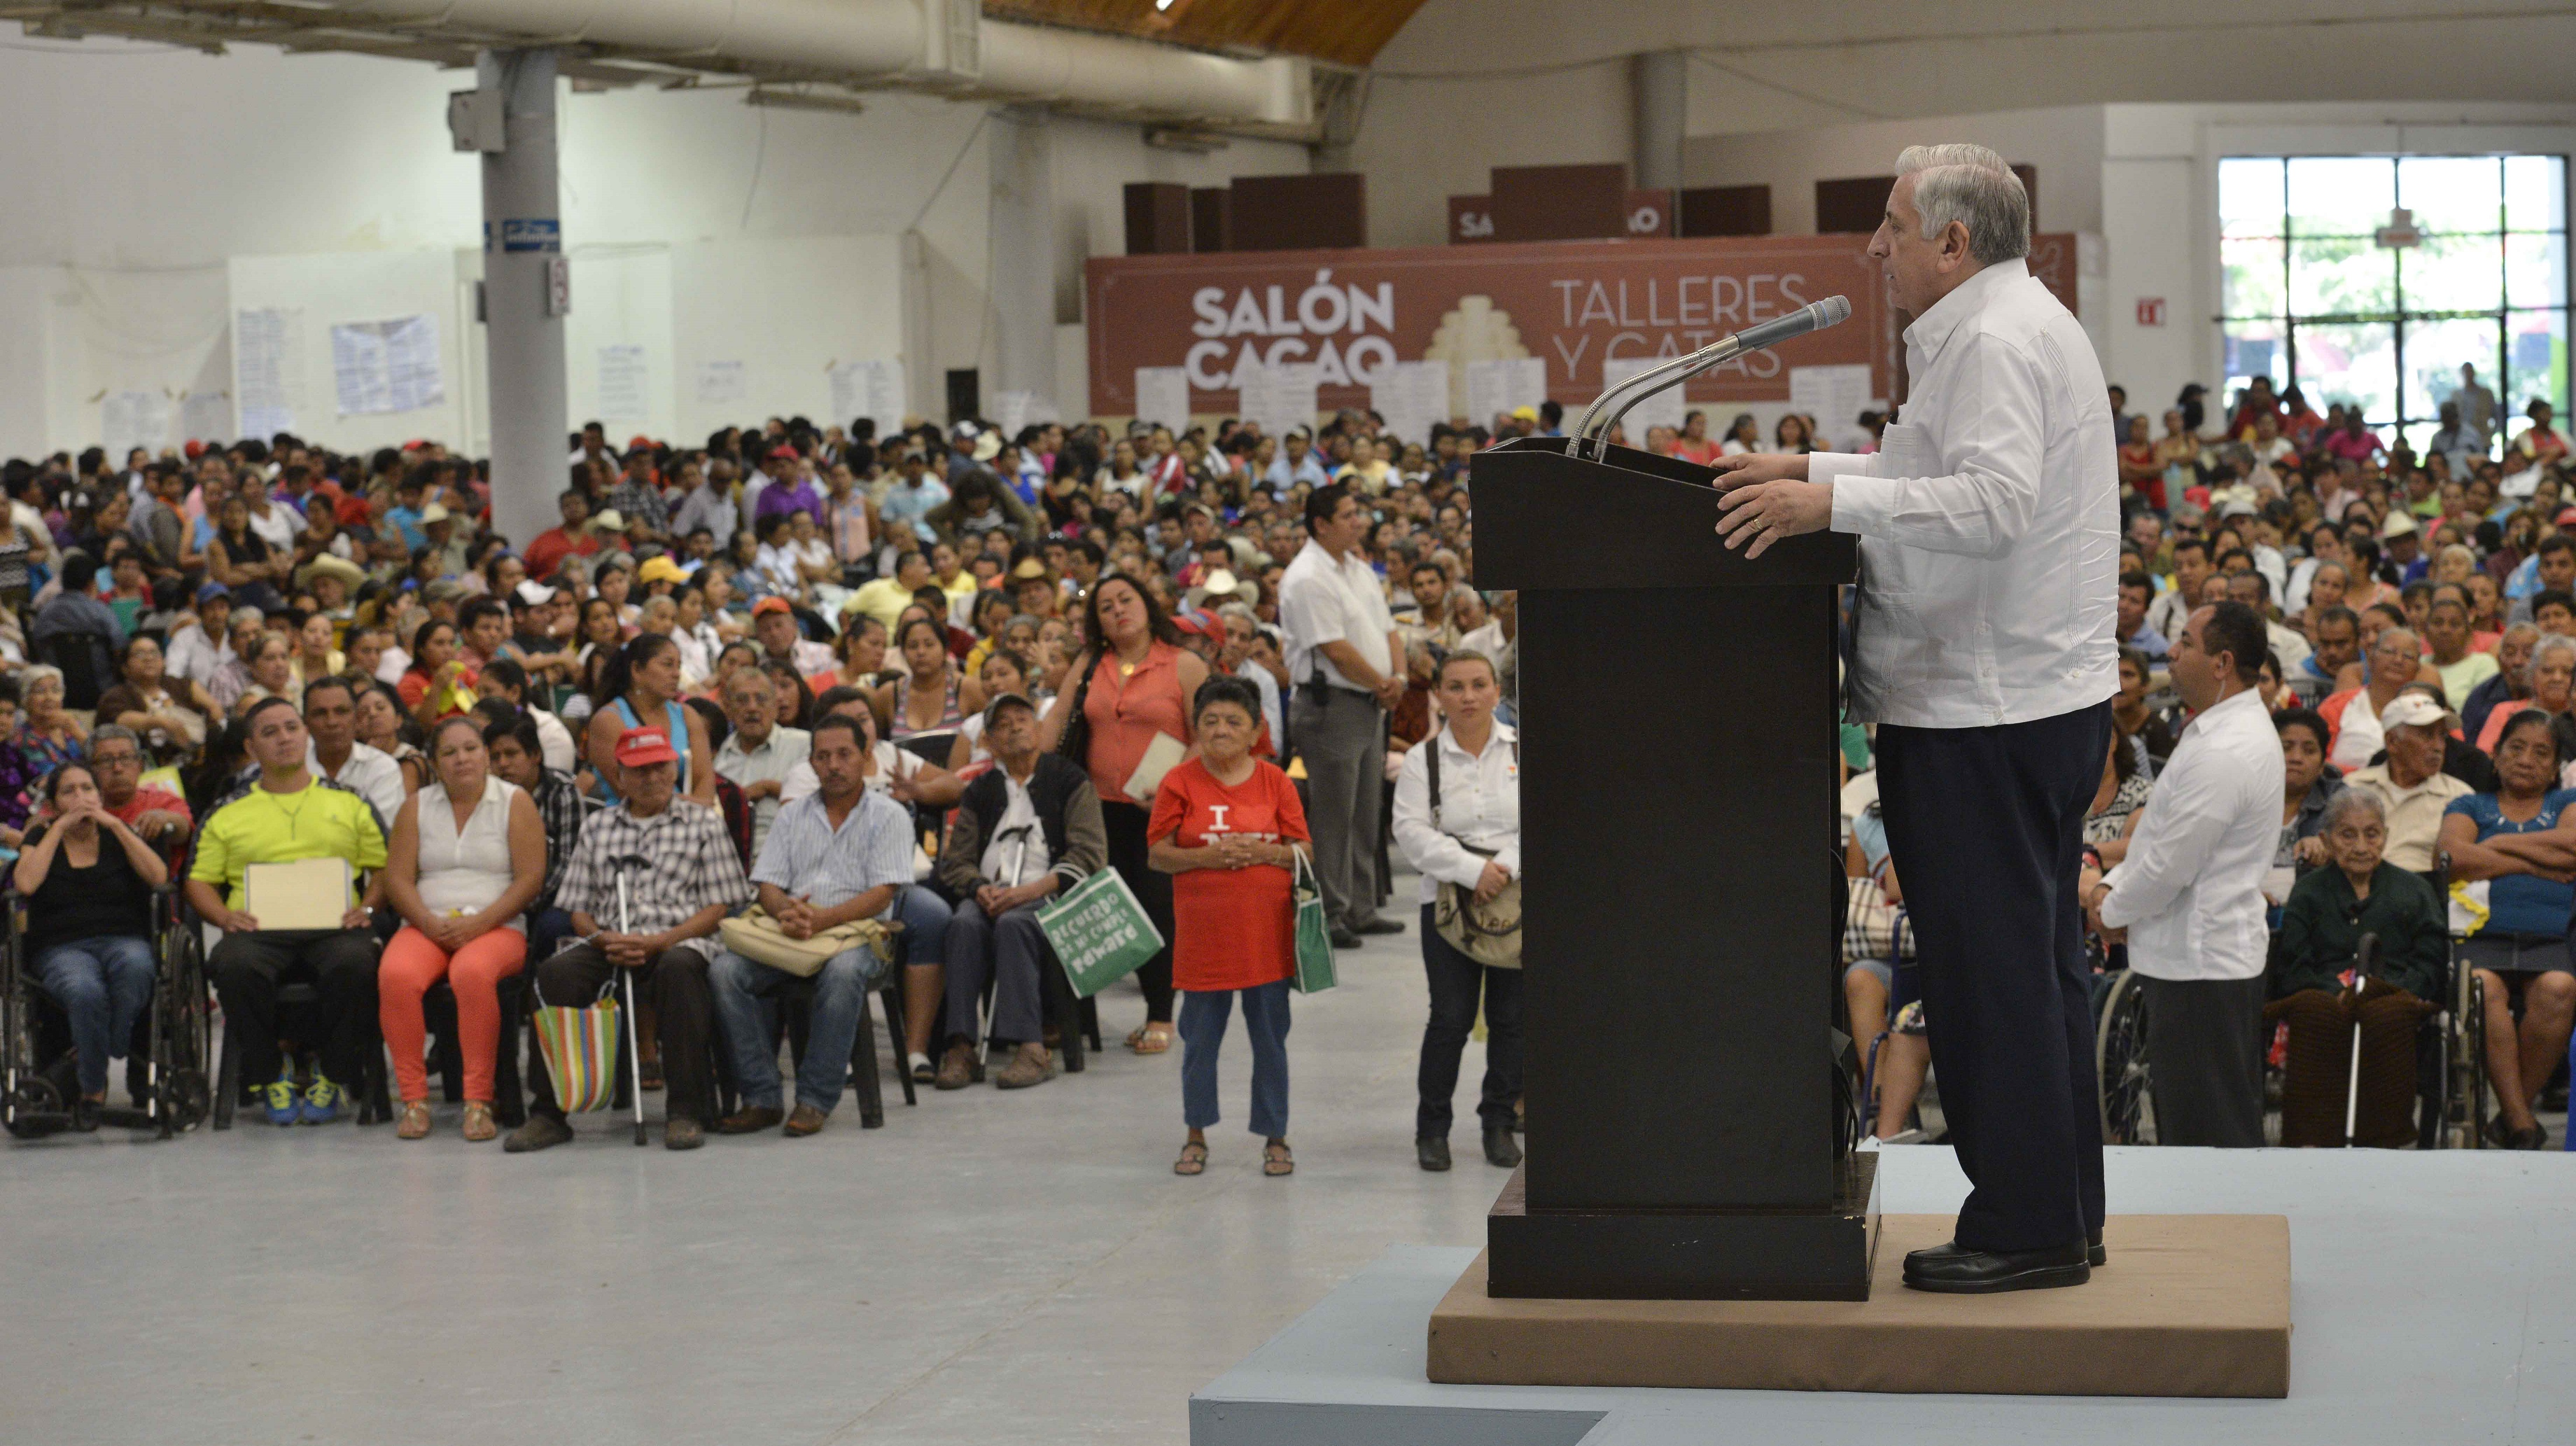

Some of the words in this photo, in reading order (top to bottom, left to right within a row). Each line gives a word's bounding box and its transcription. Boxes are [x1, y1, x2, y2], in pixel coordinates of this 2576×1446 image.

[1192, 268, 1395, 338] SALÓN
[1551, 273, 1808, 328] TALLERES
[1552, 333, 1590, 381] Y
[1209, 805, 1230, 831] I
